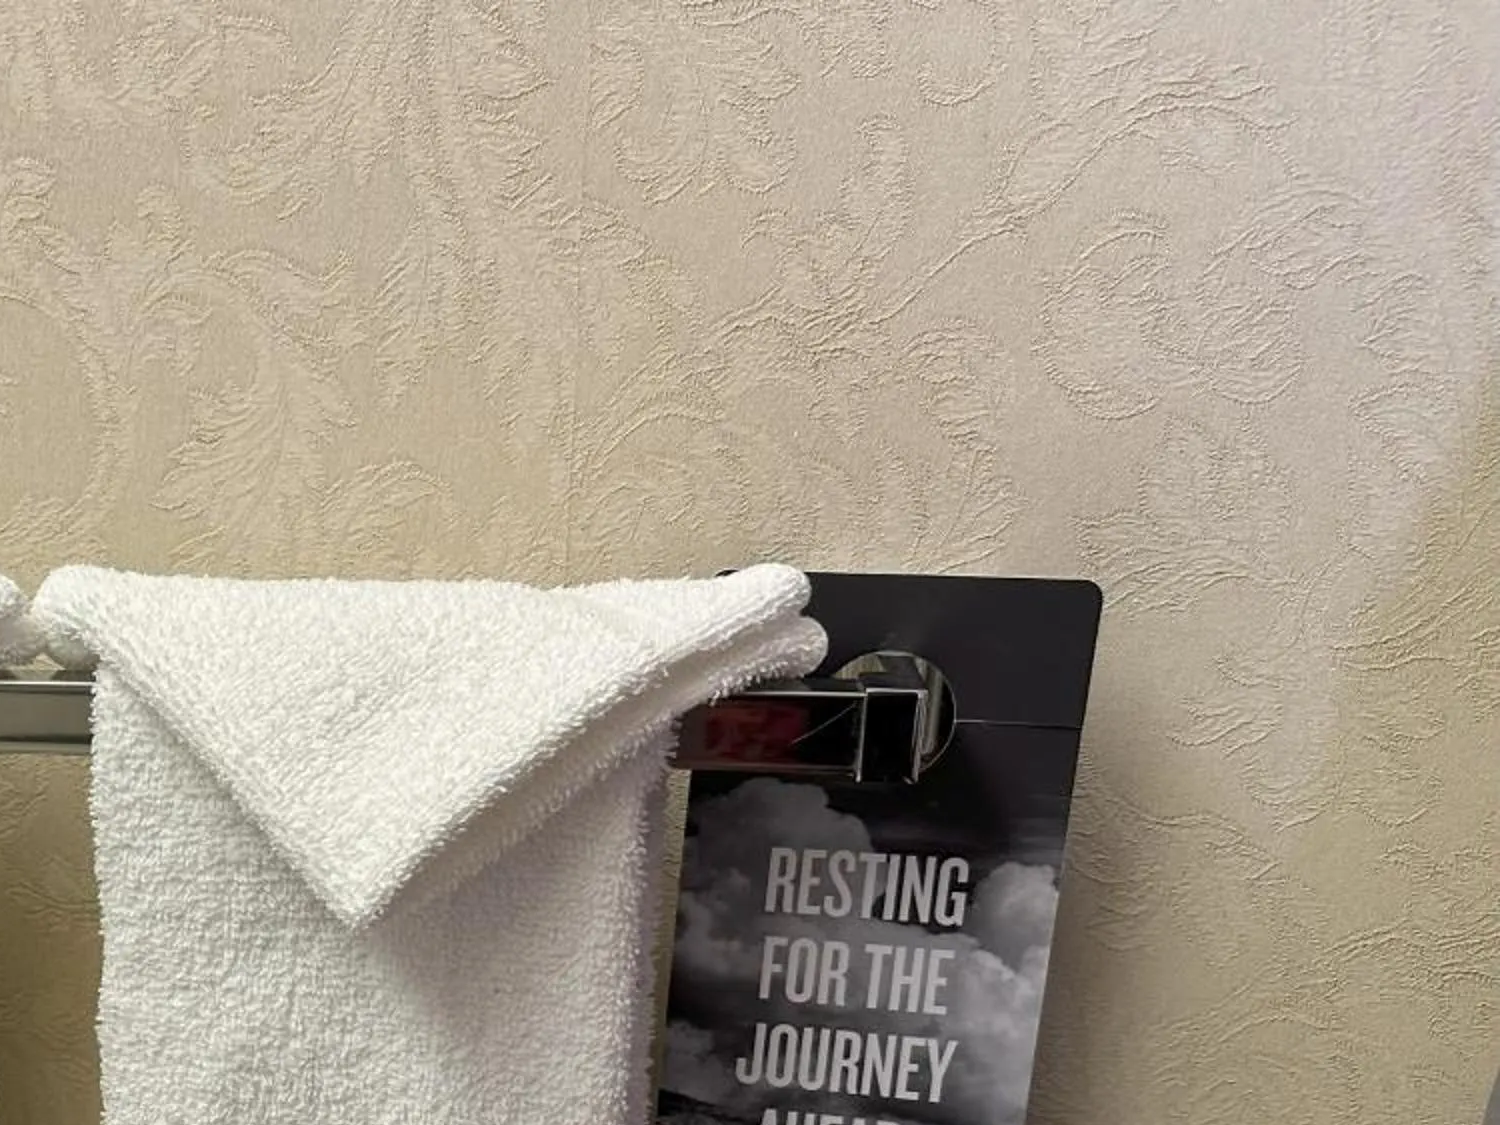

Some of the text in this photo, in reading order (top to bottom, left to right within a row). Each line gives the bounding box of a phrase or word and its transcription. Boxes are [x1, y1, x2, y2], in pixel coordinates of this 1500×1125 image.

[764, 847, 969, 927] RESTING
[758, 935, 956, 1015] FOR THE
[735, 1023, 958, 1103] JOURNEY
